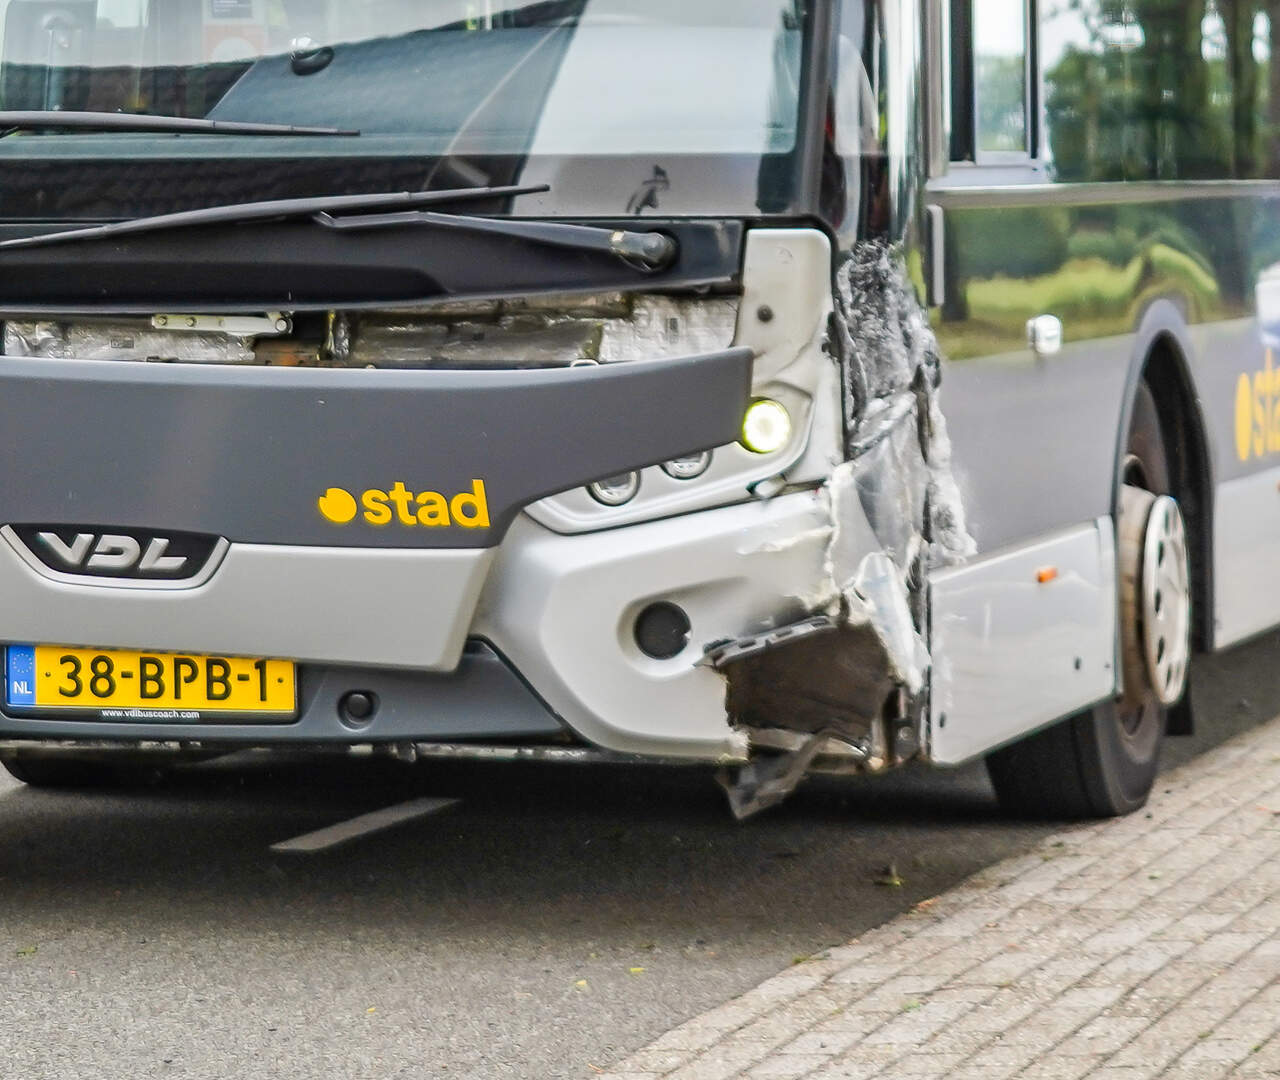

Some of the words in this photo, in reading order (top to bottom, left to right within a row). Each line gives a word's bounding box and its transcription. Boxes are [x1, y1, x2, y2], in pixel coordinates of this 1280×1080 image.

[361, 478, 491, 528] stad
[37, 531, 188, 570] VDL
[13, 680, 33, 695] NL
[58, 655, 268, 702] 38-BPB-1
[101, 708, 200, 720] www.vdlbuscoach.com
